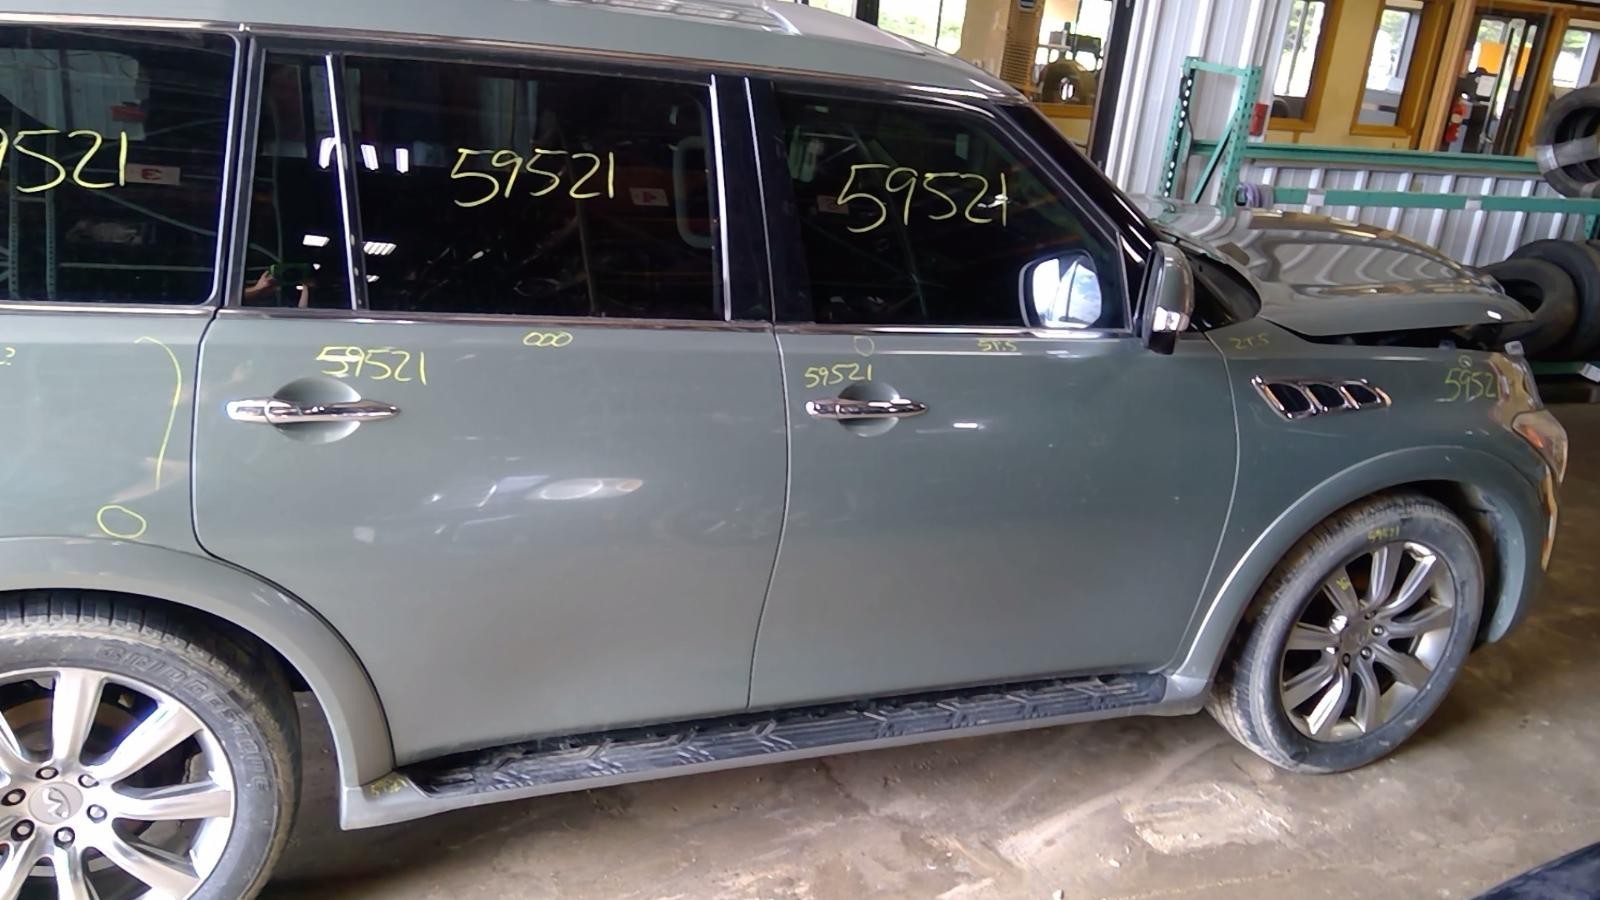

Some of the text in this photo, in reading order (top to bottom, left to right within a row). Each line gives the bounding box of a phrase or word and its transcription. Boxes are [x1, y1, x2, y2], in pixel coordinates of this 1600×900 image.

[0, 127, 128, 194] 521
[450, 147, 616, 208] 59521
[835, 163, 1009, 232] 59521
[315, 345, 427, 385] 59521
[803, 363, 873, 389] 59521
